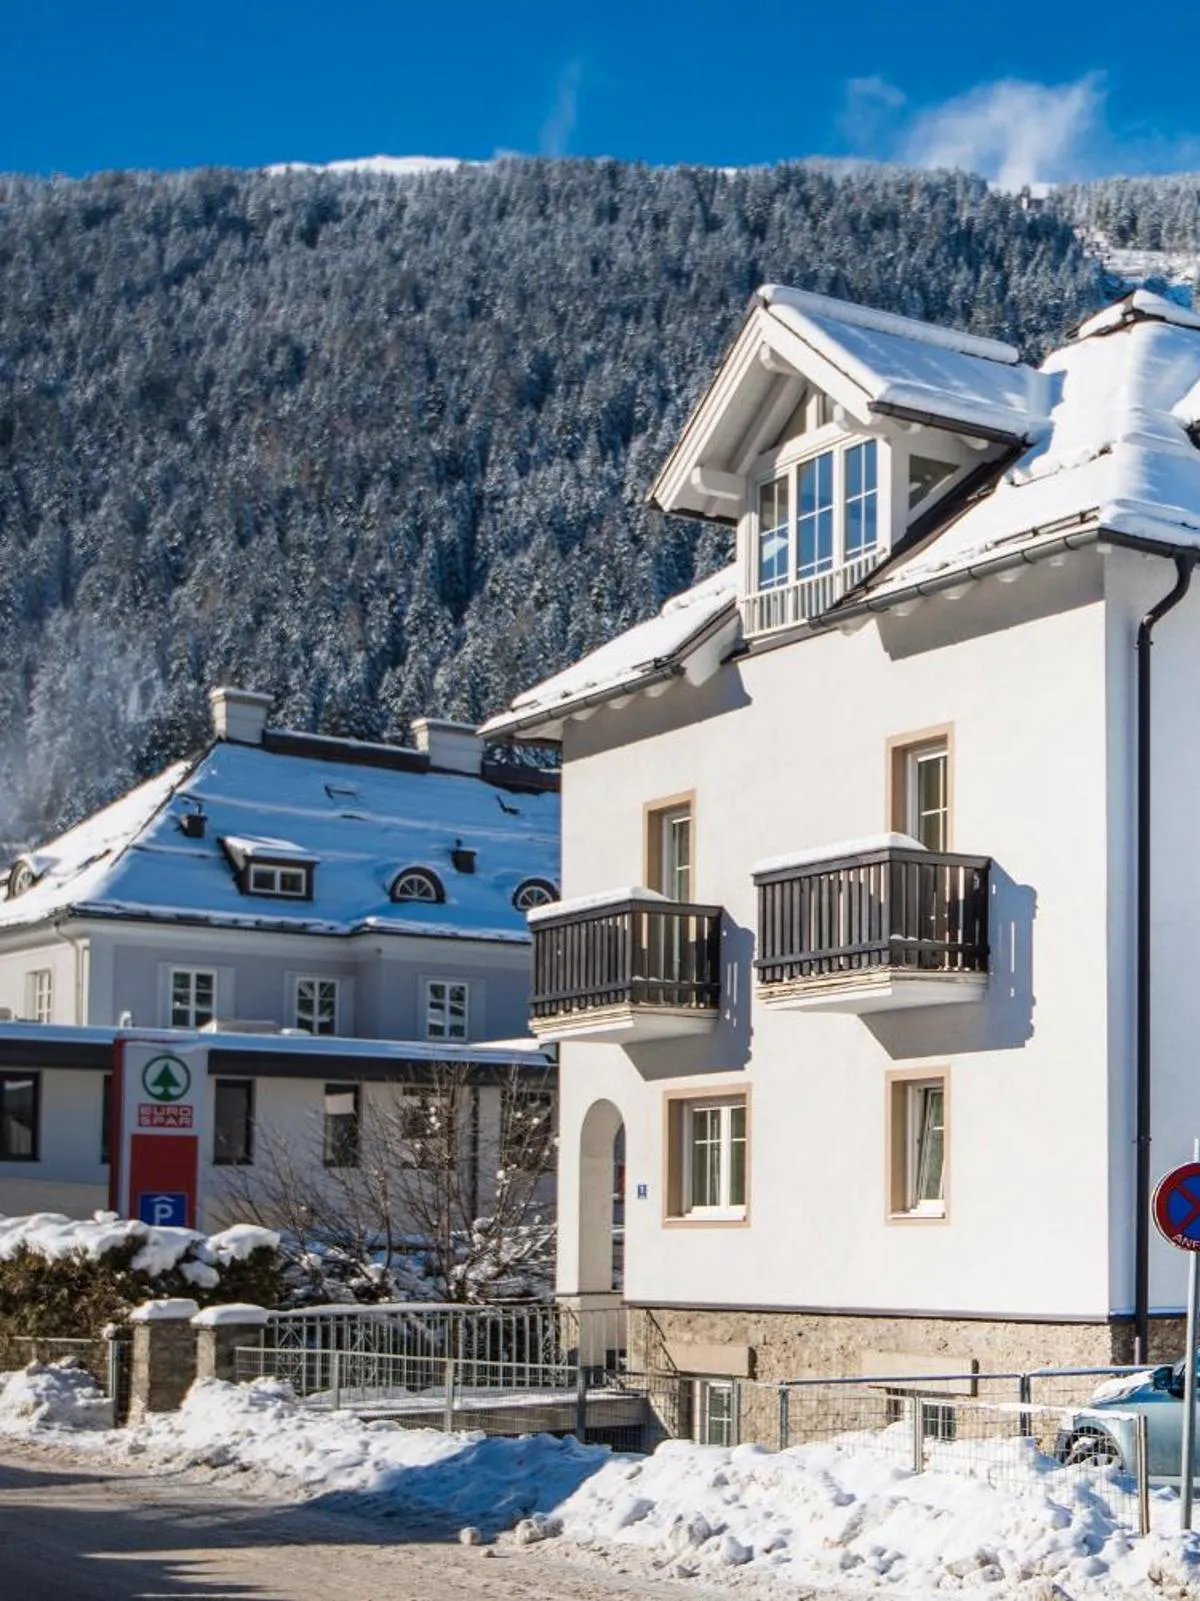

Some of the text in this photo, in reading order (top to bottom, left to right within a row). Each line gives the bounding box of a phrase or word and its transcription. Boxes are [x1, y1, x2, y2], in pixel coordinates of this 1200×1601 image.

[140, 1106, 192, 1116] EURO
[140, 1116, 191, 1126] SPAR
[154, 1204, 173, 1225] P
